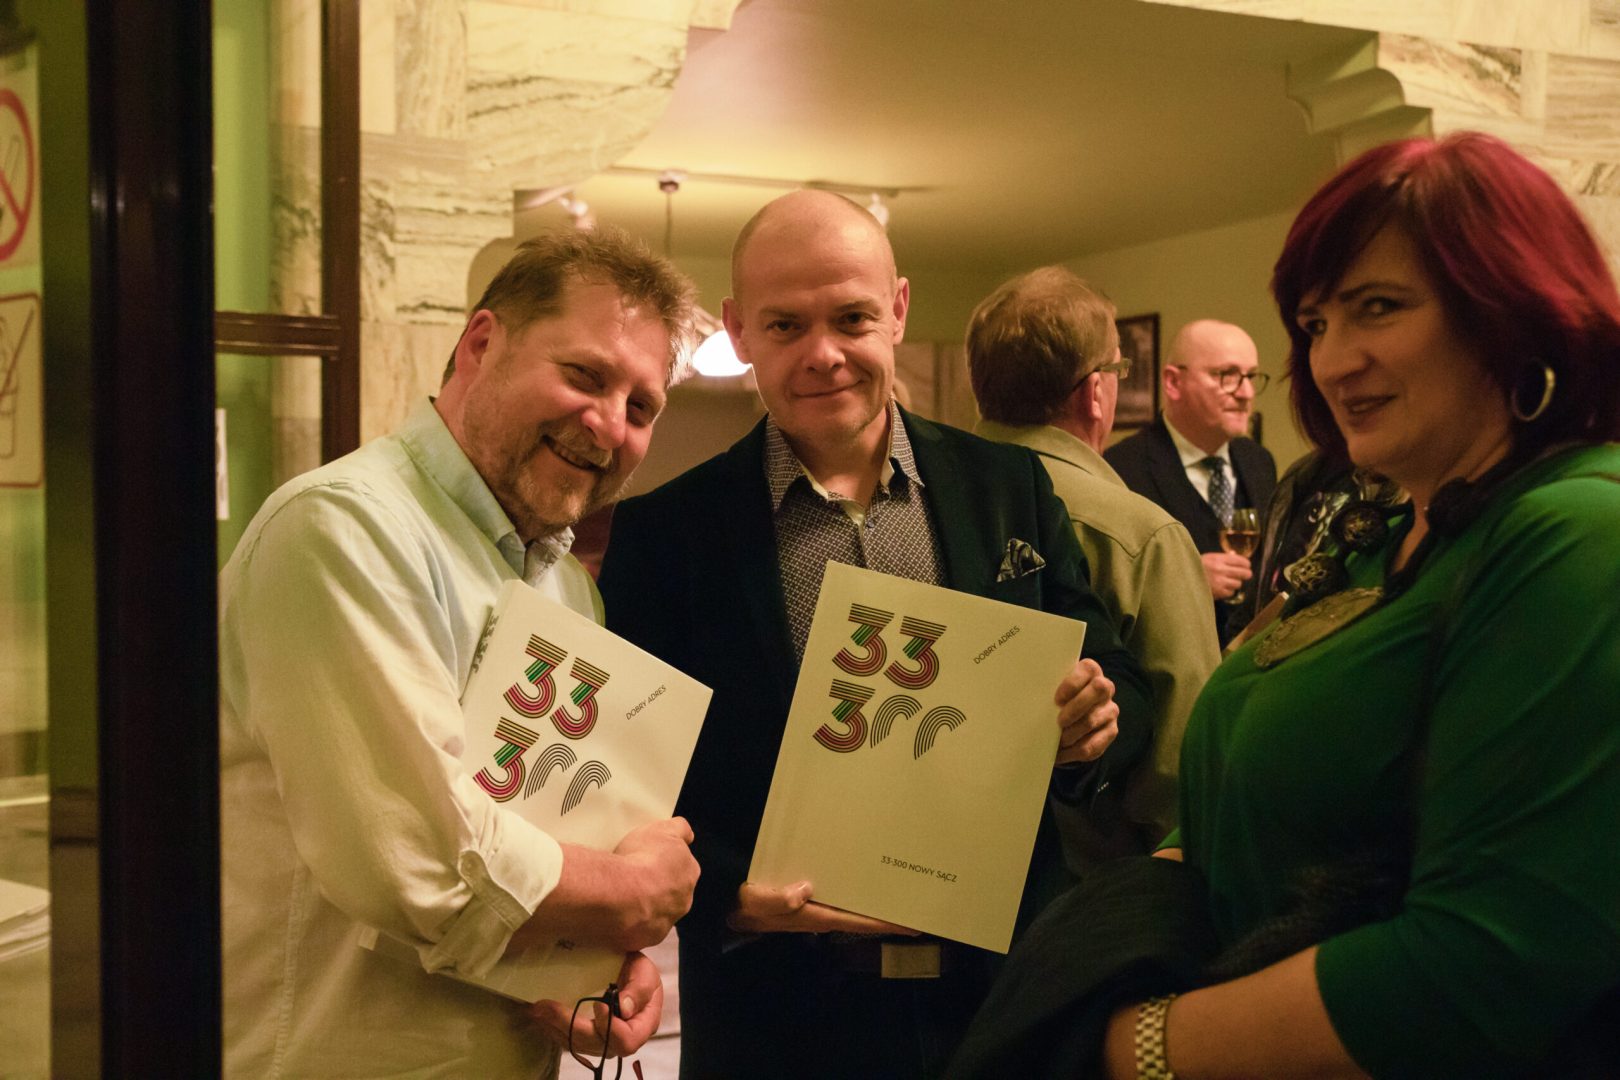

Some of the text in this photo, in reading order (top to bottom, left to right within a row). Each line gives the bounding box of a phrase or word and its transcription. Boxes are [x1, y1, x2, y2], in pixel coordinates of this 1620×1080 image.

[973, 626, 1020, 664] DOBRY ADRES
[626, 684, 666, 720] DOBRY ADRES
[881, 855, 908, 869] 33-300
[908, 864, 935, 876] NOWY
